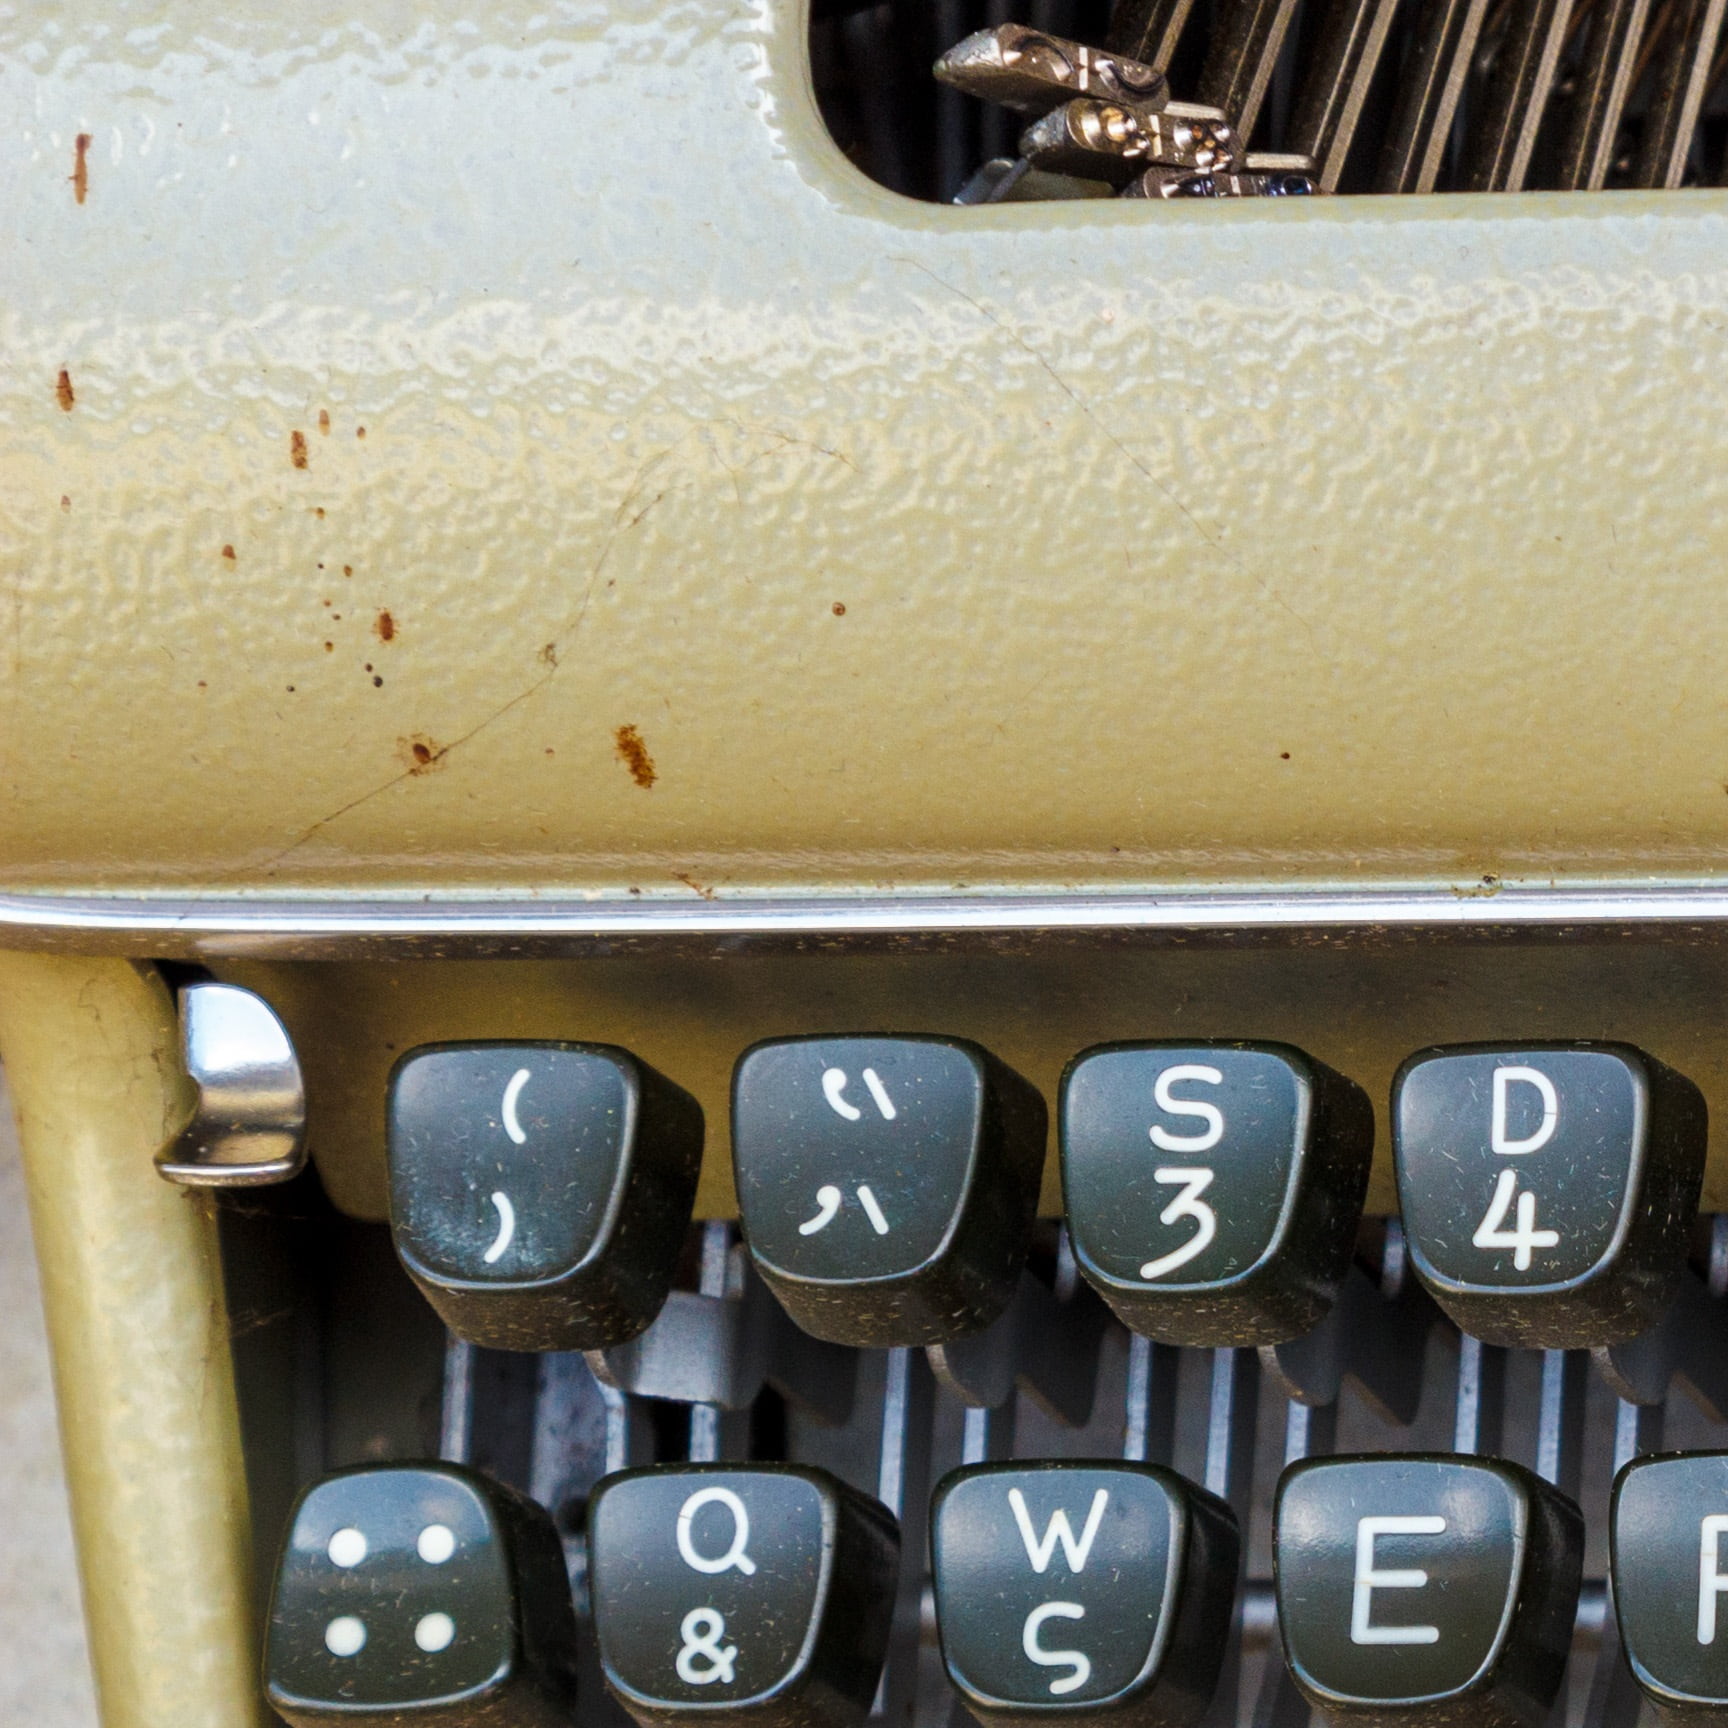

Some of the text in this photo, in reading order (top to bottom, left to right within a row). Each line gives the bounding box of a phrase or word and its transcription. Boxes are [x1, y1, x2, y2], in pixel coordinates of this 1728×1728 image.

[1148, 1063, 1225, 1153] S
[1490, 1065, 1559, 1156] D
[1139, 1167, 1216, 1280] 3
[1472, 1168, 1560, 1272] 4
[675, 1486, 757, 1576] Q
[1007, 1487, 1110, 1574] W
[675, 1607, 738, 1684] &
